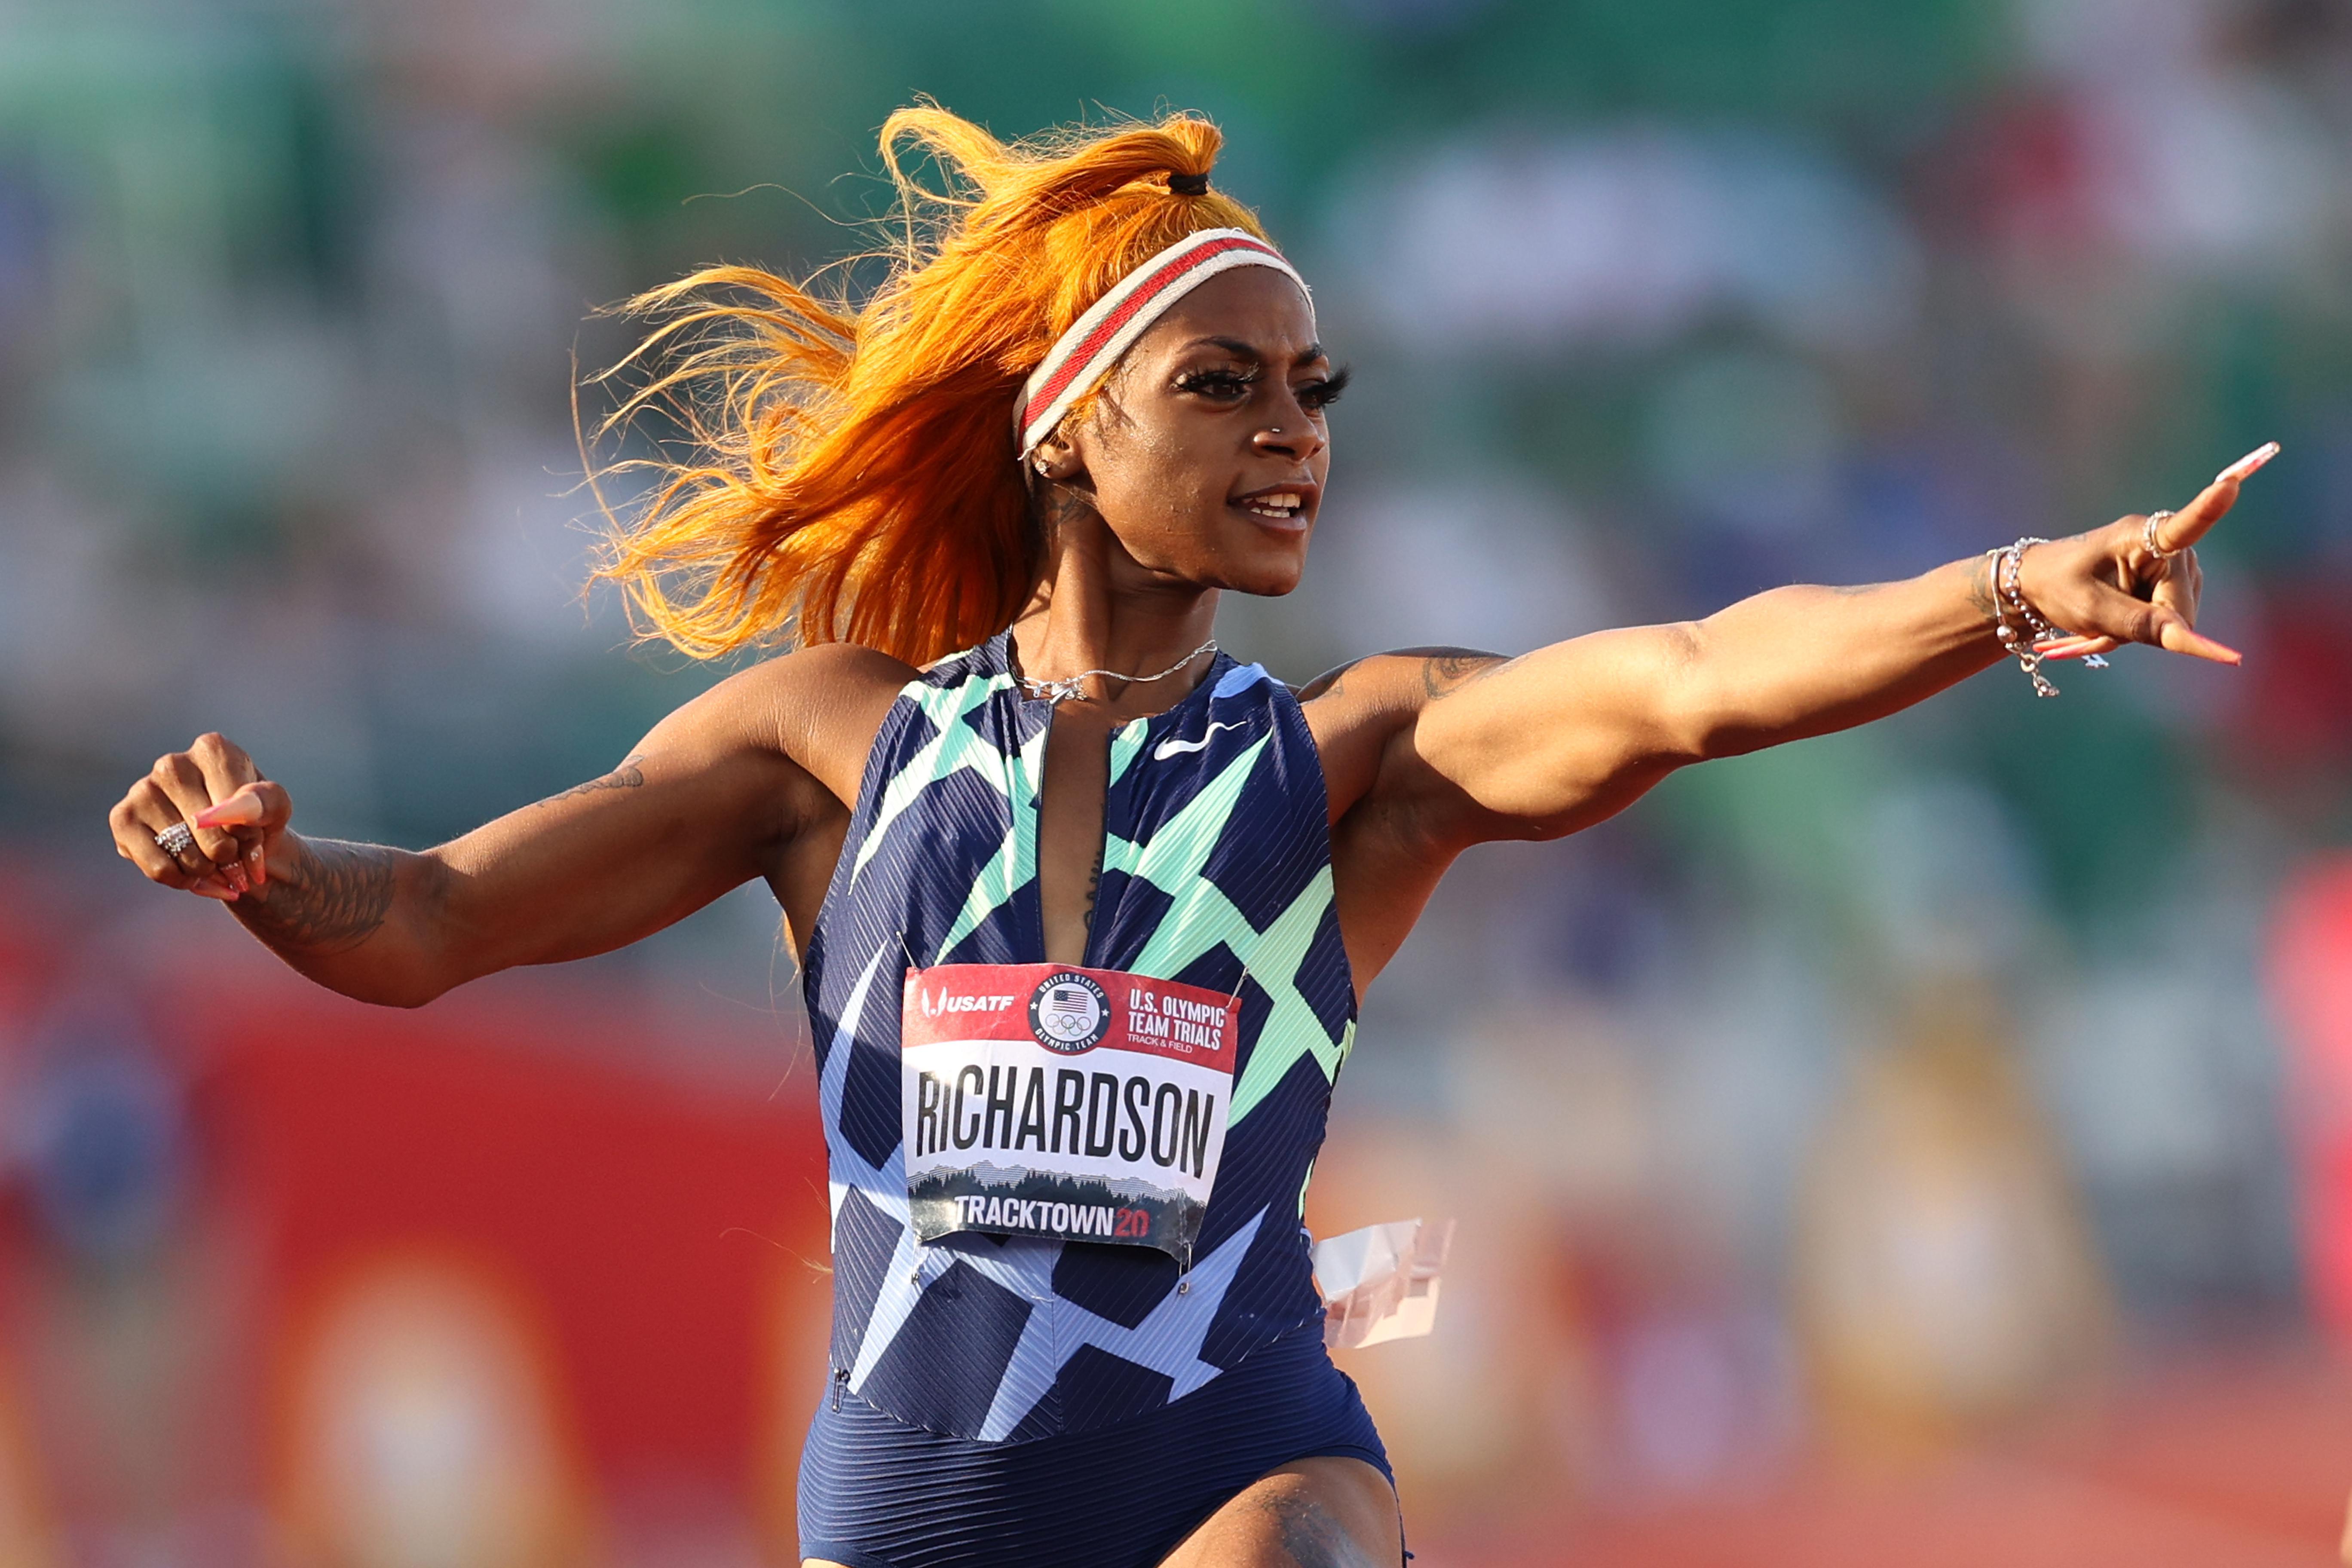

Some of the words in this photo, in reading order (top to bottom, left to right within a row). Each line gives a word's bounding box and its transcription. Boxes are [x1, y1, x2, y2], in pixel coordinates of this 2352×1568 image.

[1039, 974, 1070, 992] UNITED
[1075, 975, 1104, 998] STATES
[946, 995, 1015, 1012] USATF
[1130, 989, 1158, 1013] U.S.
[1163, 996, 1225, 1028] OLYMPIC
[1035, 1028, 1071, 1050] OLYMPIC
[1075, 1034, 1099, 1050] TEAM
[1128, 1011, 1169, 1038] TEAM
[1173, 1019, 1222, 1050] TRIALS
[1127, 1033, 1159, 1046] TRACK
[1160, 1039, 1167, 1047] &
[1168, 1041, 1193, 1053] FIELD
[916, 1064, 1215, 1179] RICHARDSON
